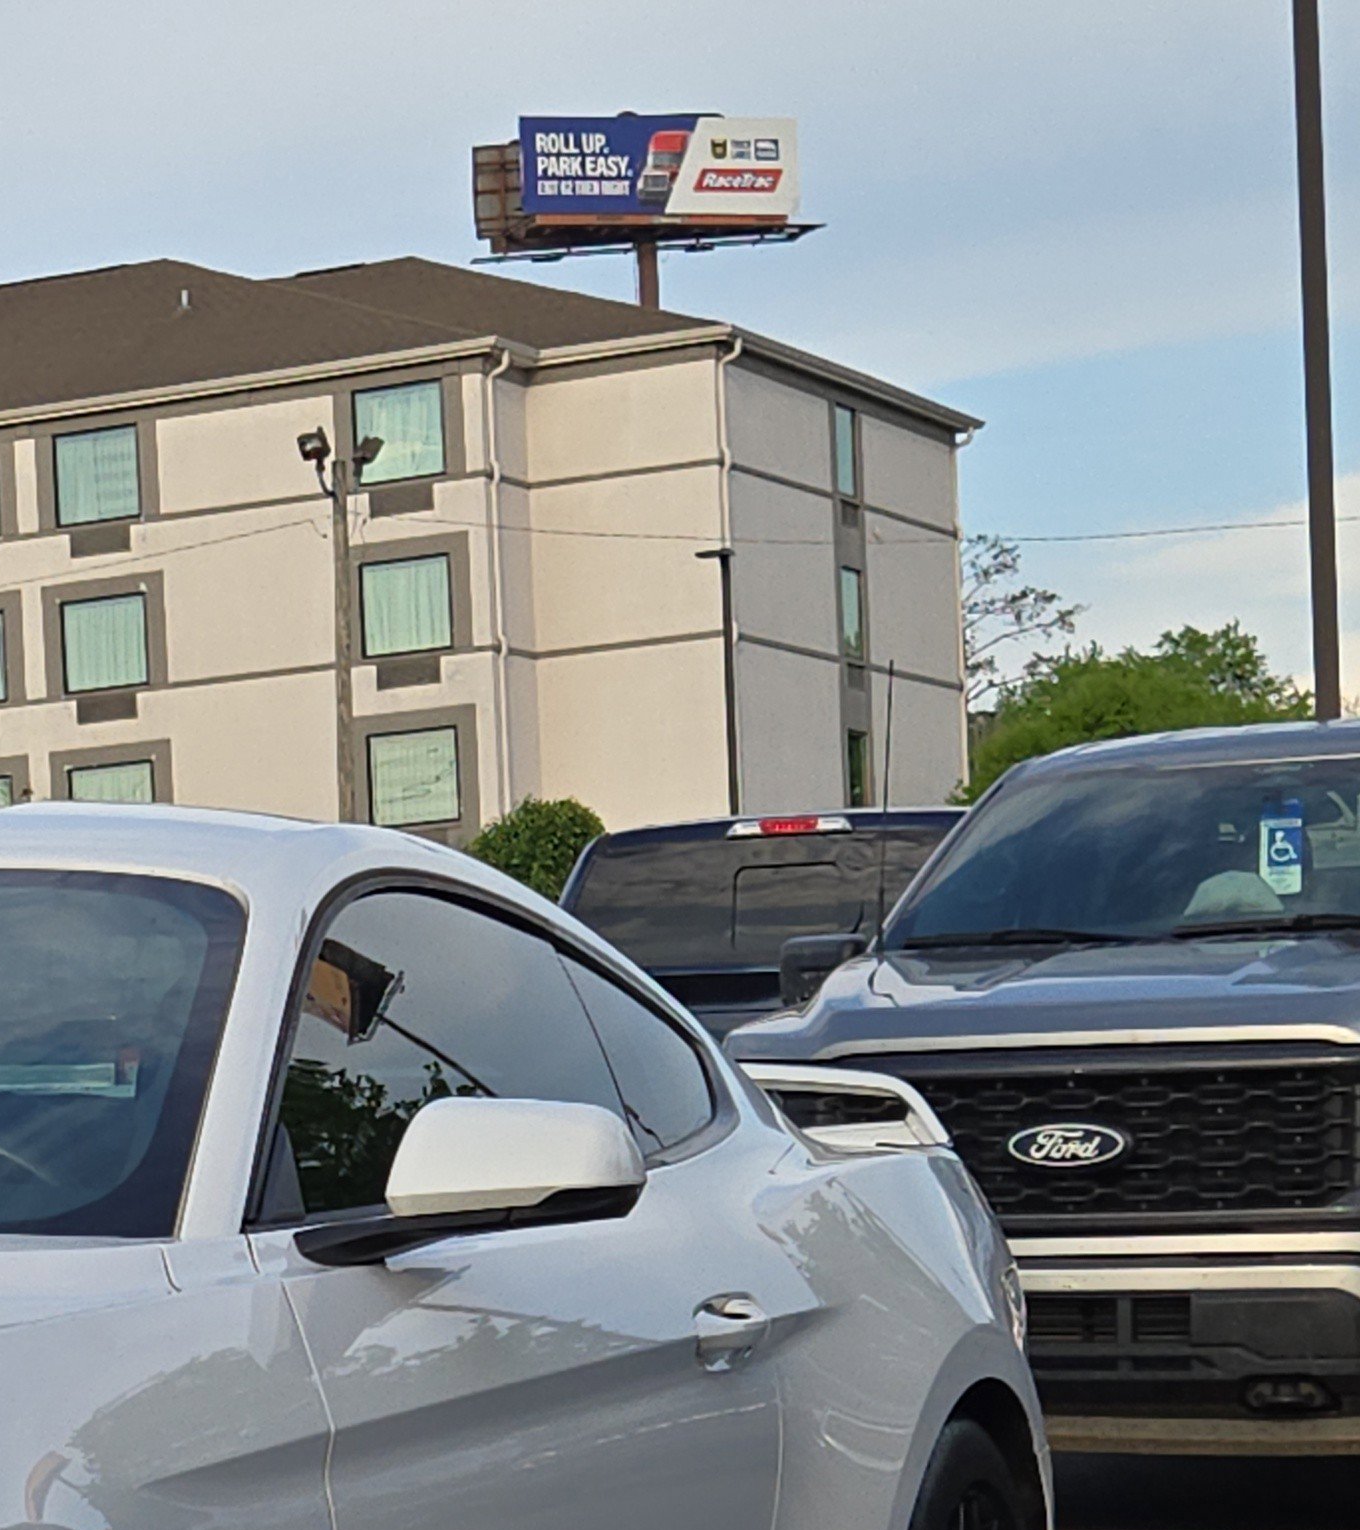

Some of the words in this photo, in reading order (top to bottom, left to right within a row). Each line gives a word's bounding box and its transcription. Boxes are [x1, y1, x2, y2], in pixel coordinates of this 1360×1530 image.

[535, 132, 580, 154] ROLL
[581, 132, 610, 154] UP.
[537, 156, 583, 177] PARK
[585, 155, 634, 178] EASY.
[1030, 1130, 1102, 1159] Ford
